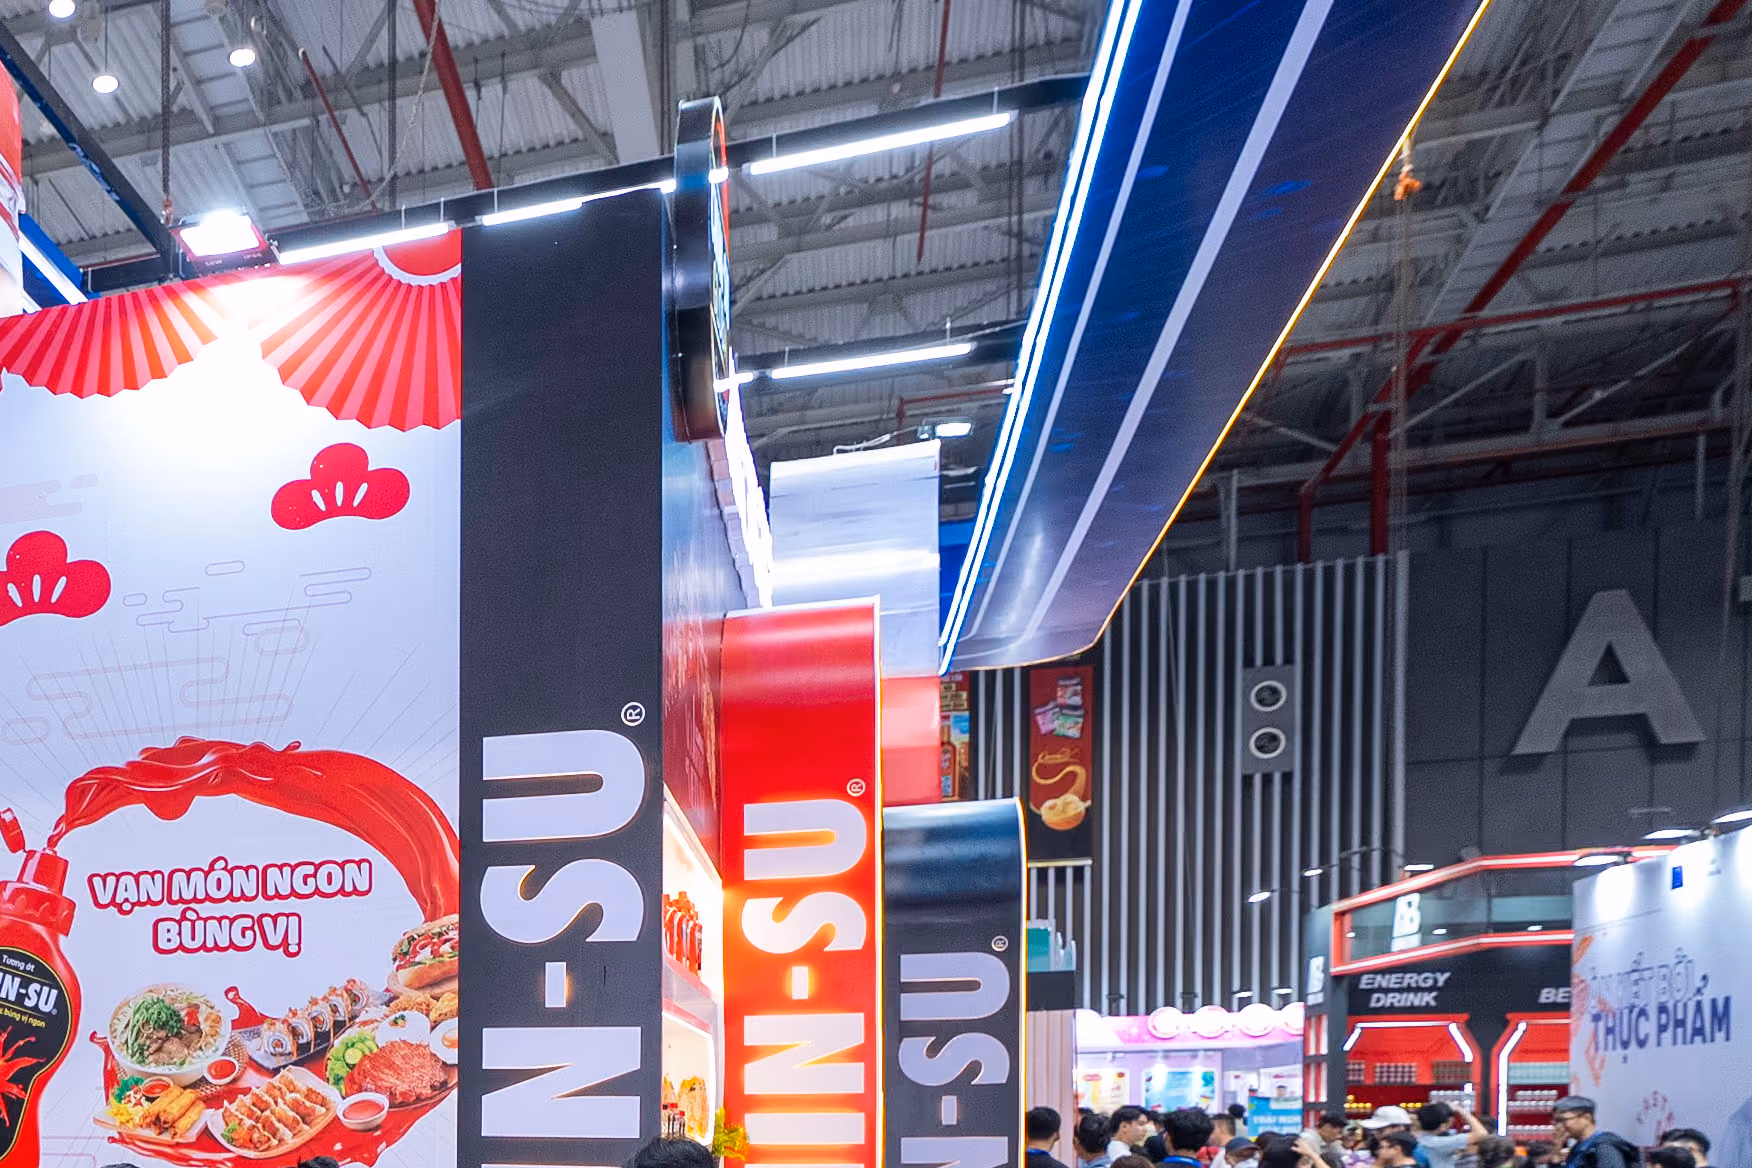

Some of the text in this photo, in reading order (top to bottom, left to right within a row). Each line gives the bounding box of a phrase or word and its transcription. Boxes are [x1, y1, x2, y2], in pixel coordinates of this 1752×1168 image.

[1510, 589, 1705, 755] A
[90, 857, 372, 914] VẠN MÓN NGON
[156, 907, 301, 956] BÙNG VỊ
[1359, 972, 1450, 989] ENERGY
[1538, 987, 1571, 1003] BE
[1369, 991, 1437, 1008] DRINK
